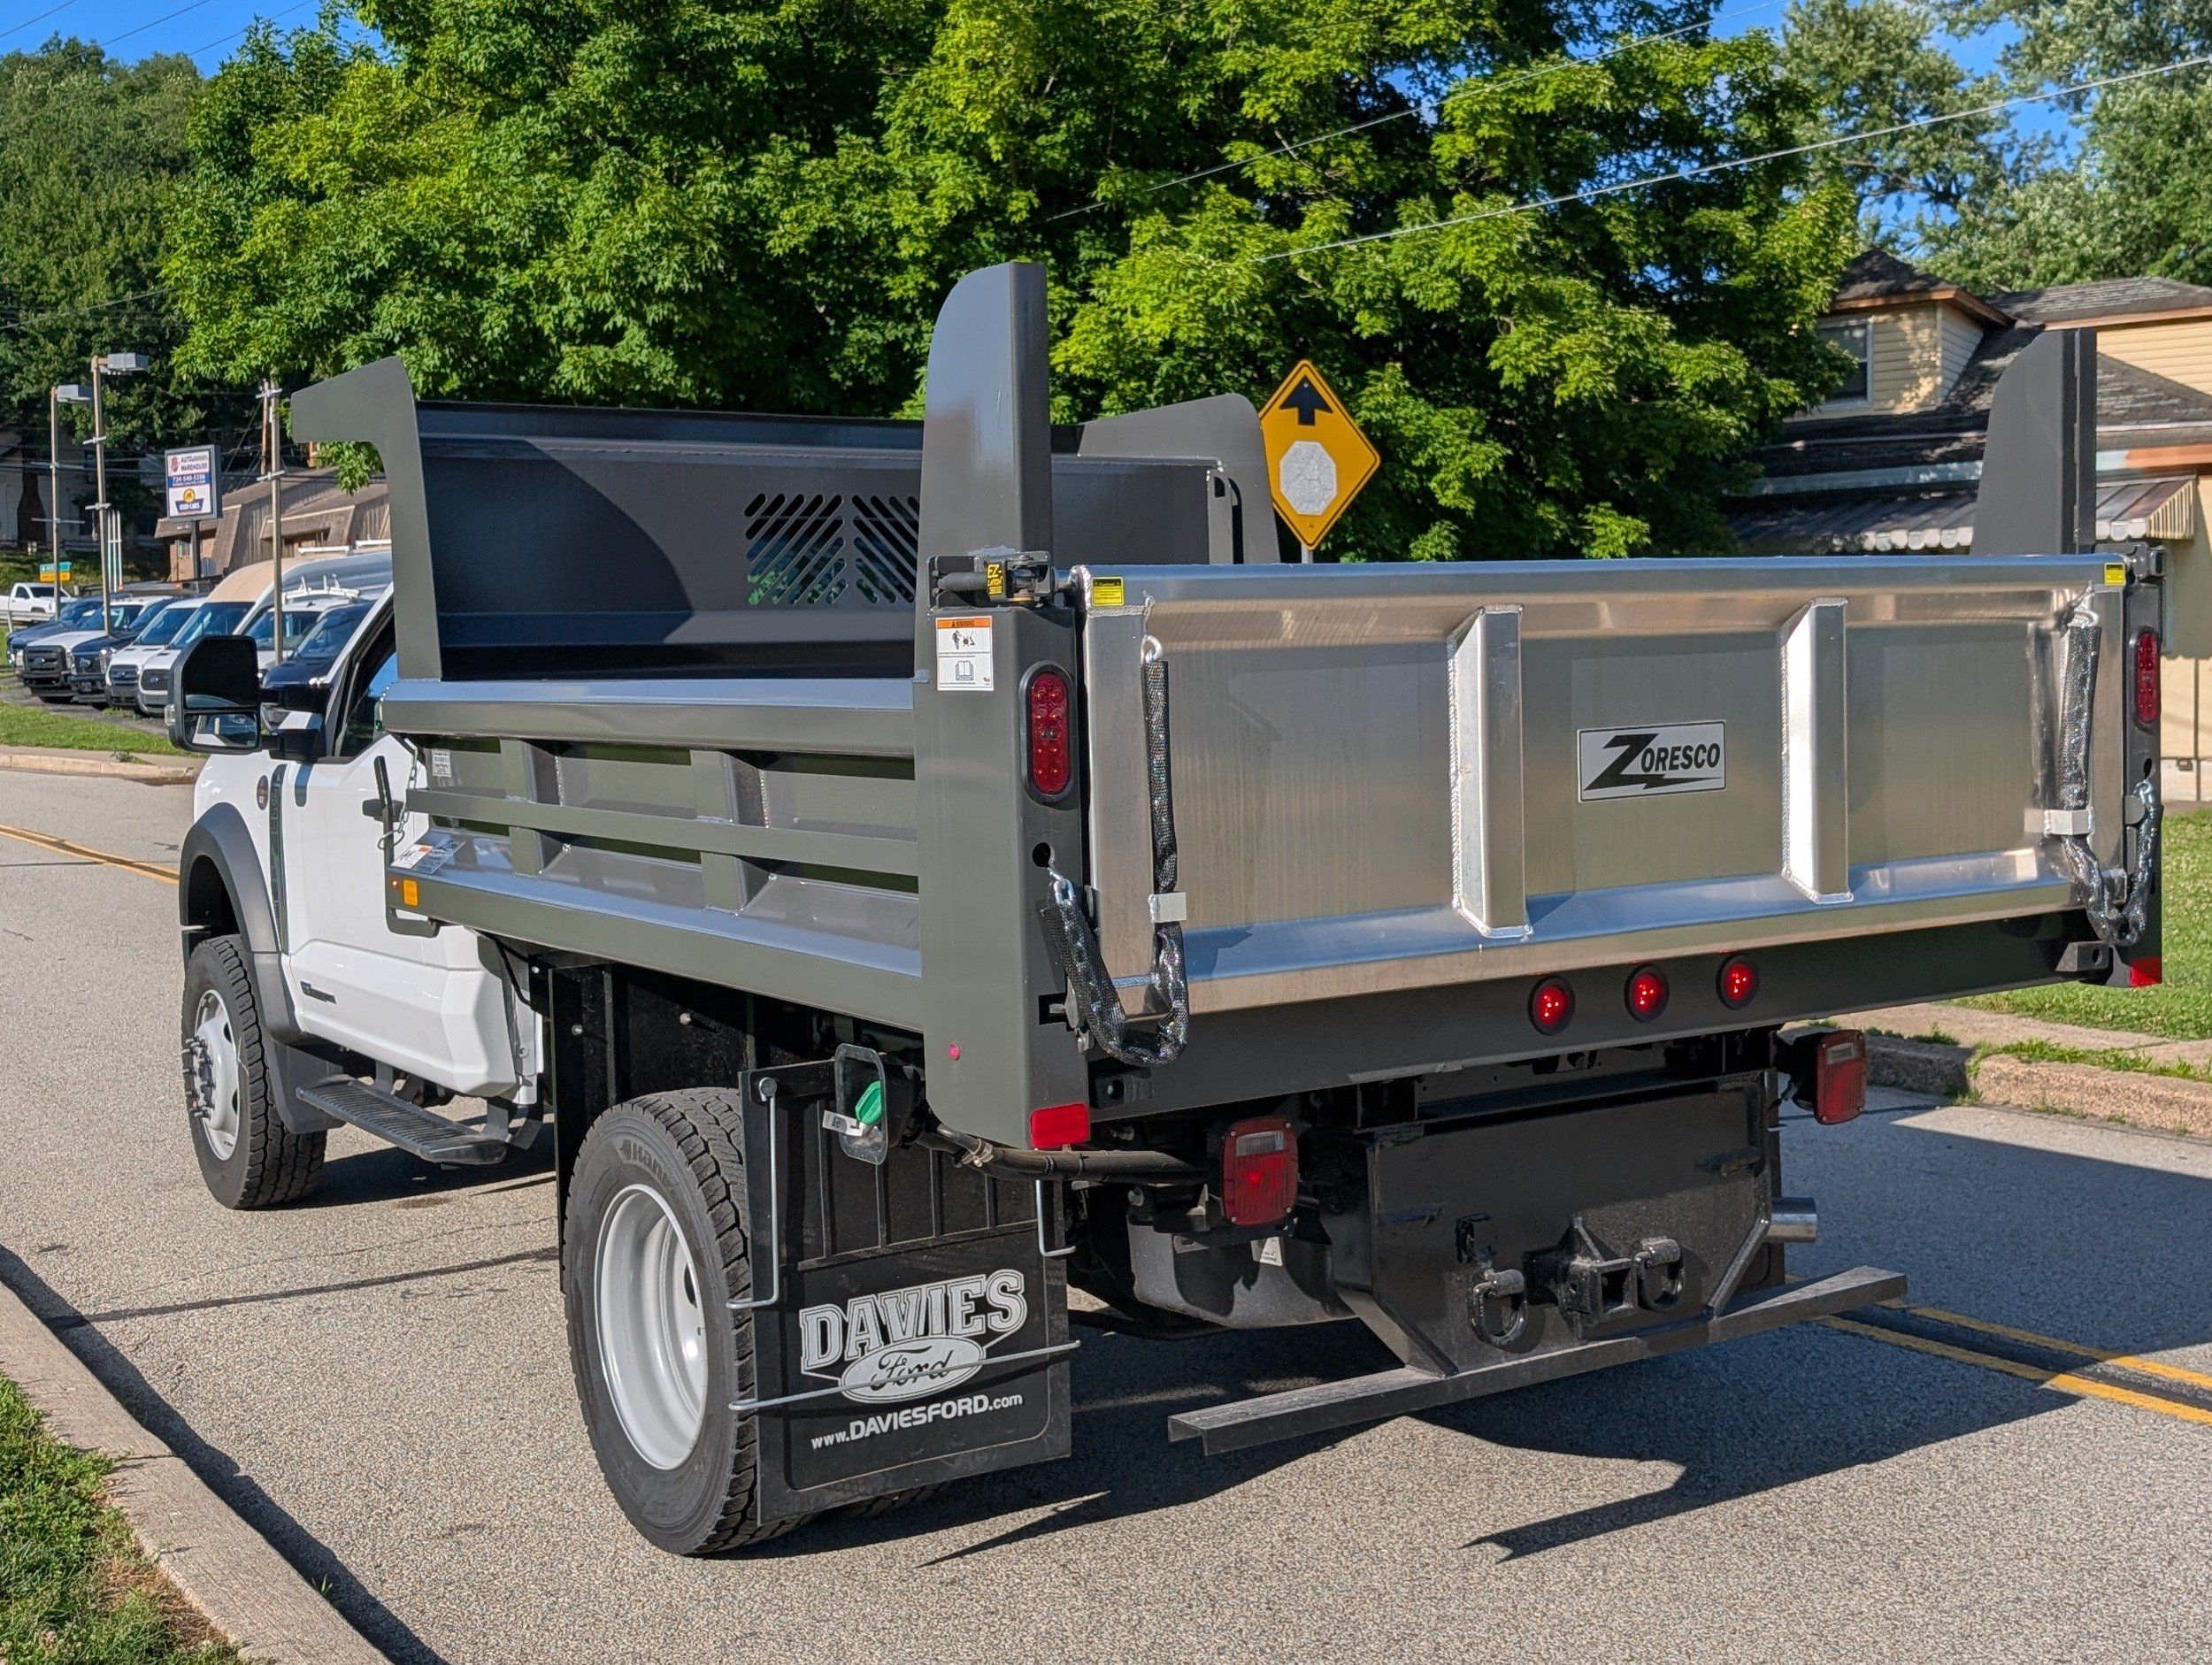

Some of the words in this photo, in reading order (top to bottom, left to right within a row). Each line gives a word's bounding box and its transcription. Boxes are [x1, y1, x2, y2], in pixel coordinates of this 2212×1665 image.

[1583, 733, 1722, 791] ZORESCO
[799, 1269, 1027, 1374] DAVIES
[870, 1346, 954, 1391] Ford
[811, 1394, 1023, 1449] www.DAVIESFORD.com
